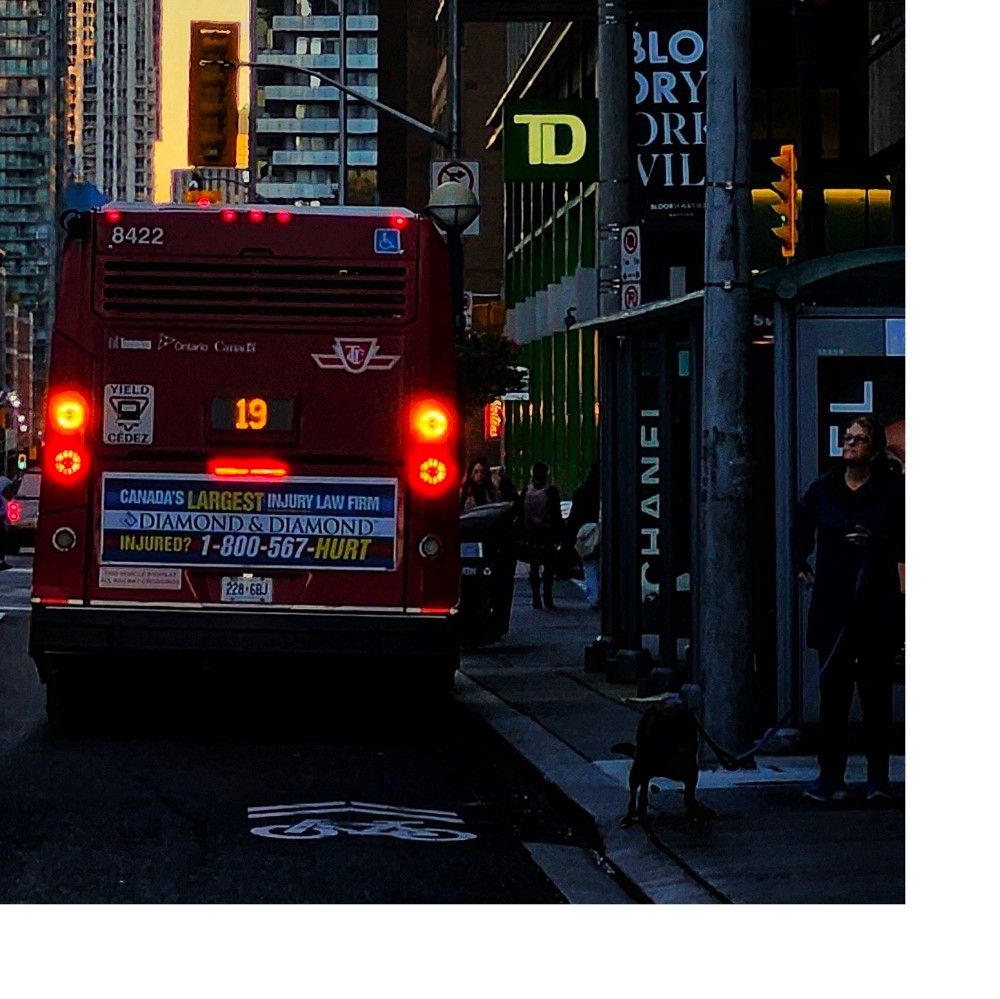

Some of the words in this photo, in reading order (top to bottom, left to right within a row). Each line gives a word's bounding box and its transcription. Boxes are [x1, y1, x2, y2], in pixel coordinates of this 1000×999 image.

[513, 114, 587, 165] TD
[111, 227, 164, 245] 8422
[110, 385, 149, 395] YIELD
[235, 398, 268, 430] 19
[120, 489, 185, 505] CANADA'S
[187, 490, 264, 512] LARGEST
[267, 493, 314, 509] INJURY
[315, 495, 345, 510] LAW
[347, 496, 380, 511] FIRM
[140, 512, 244, 531] DIAMOND
[248, 516, 263, 532] &
[269, 516, 374, 535] DIAMOND
[119, 535, 192, 552] INJURED?
[200, 534, 372, 560] 1-800-567-HURT
